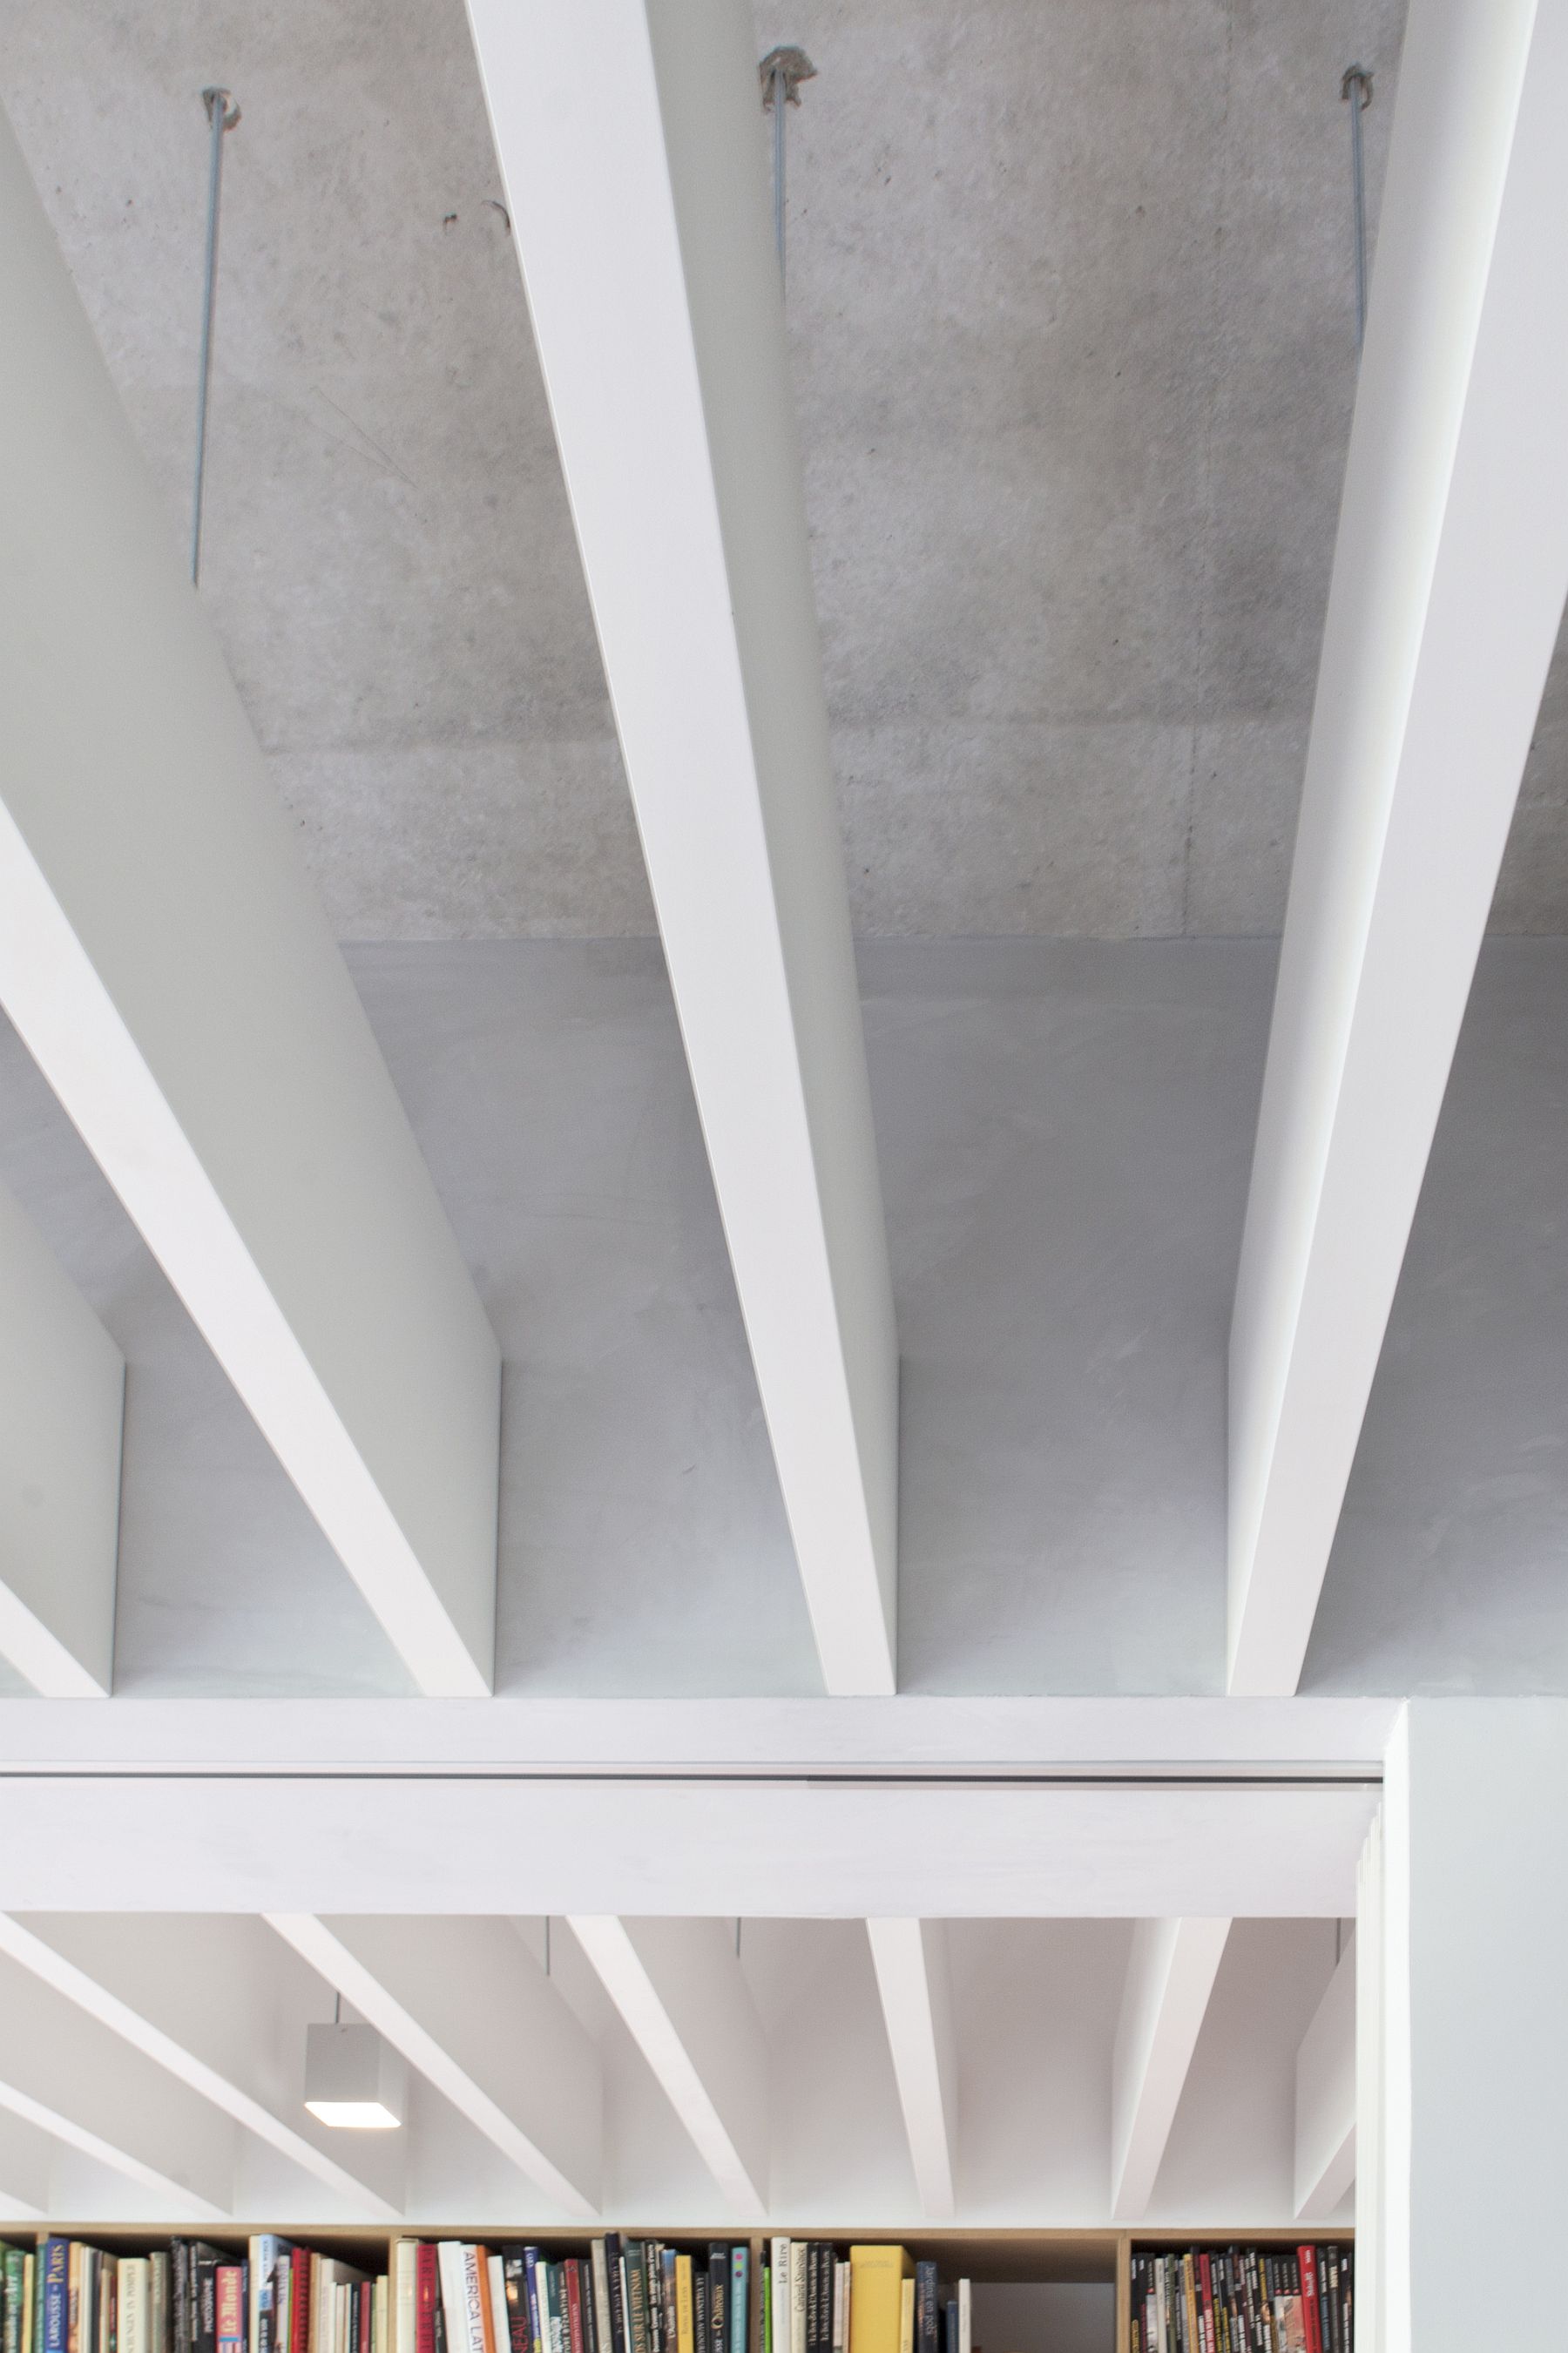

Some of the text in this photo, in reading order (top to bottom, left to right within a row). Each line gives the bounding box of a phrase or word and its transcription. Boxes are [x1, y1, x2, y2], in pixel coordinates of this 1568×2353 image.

[46, 2244, 65, 2284] PARIS
[777, 2243, 787, 2267] Rire
[220, 2270, 237, 2317] Monde
[629, 2268, 643, 2309] VIETNAM
[778, 2272, 787, 2284] Le
[924, 2265, 935, 2299] Jardins
[49, 2293, 61, 2348] LAROUSSE
[926, 2302, 933, 2312] en
